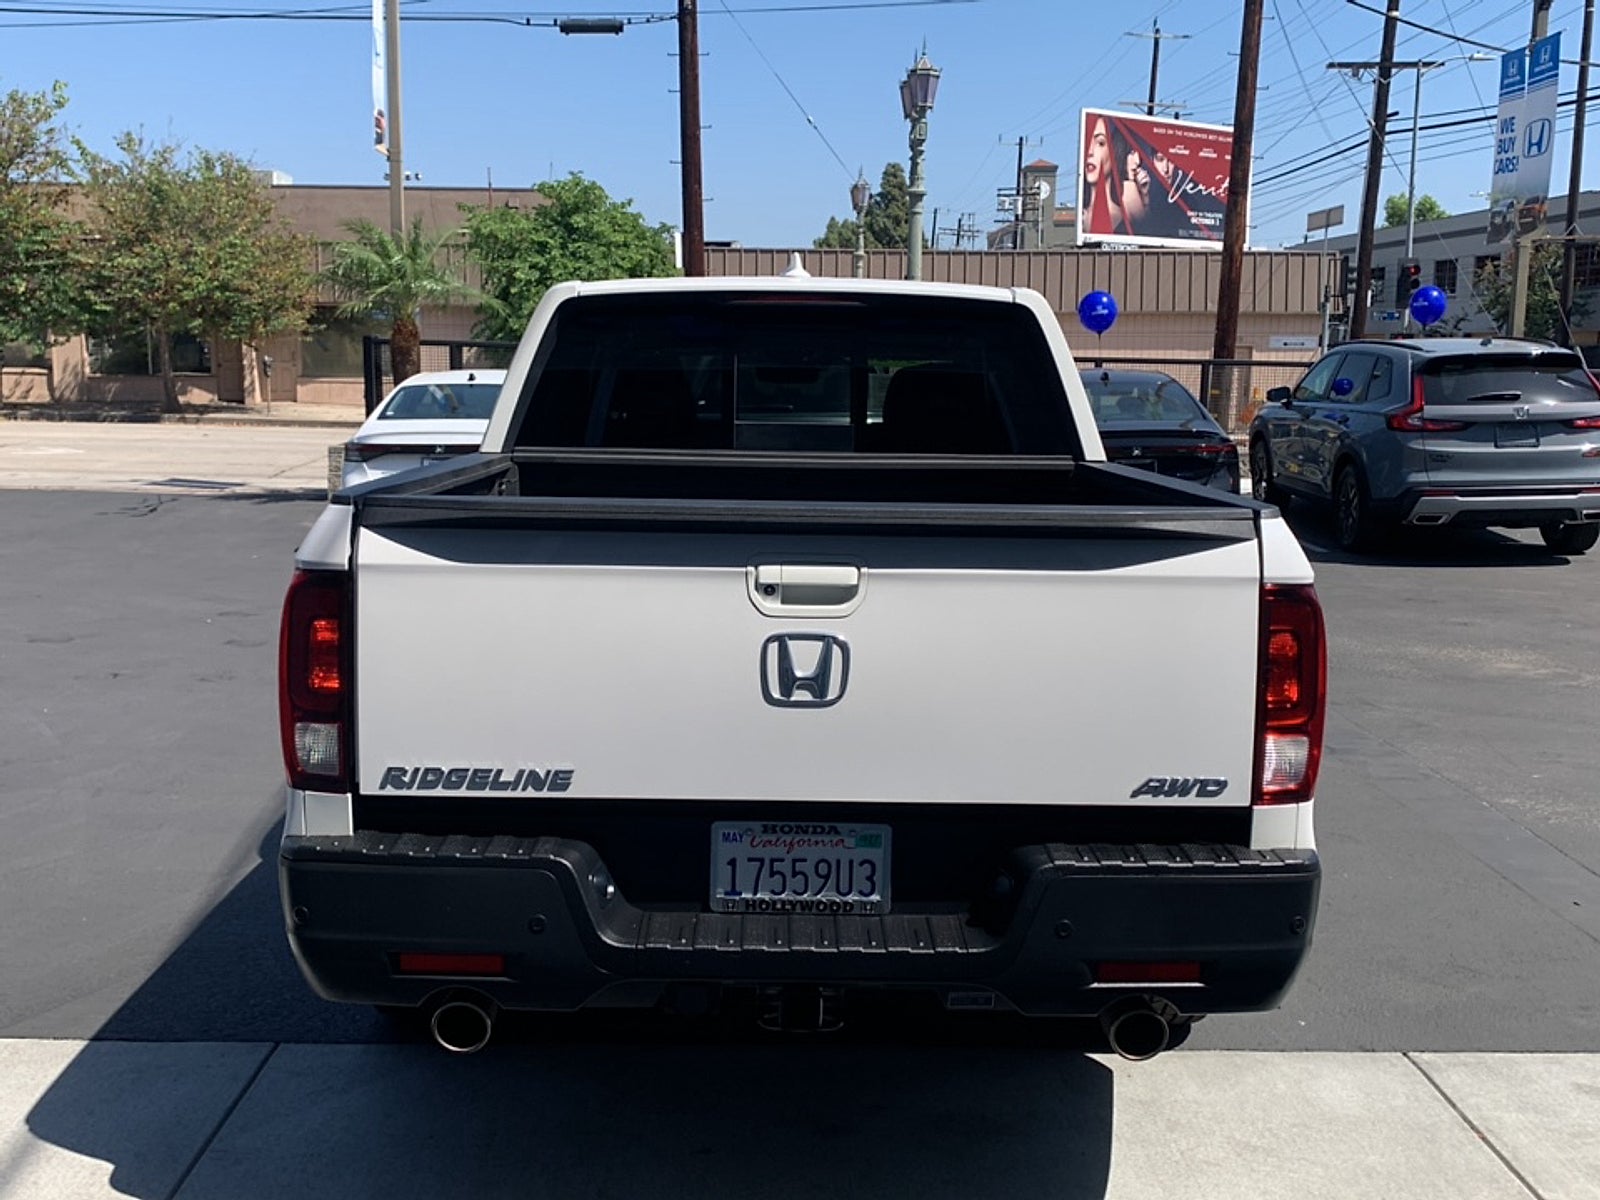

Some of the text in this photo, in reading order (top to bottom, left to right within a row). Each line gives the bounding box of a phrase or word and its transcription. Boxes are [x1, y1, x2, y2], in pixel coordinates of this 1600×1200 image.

[1500, 117, 1516, 133] WE
[1497, 136, 1517, 155] BUY
[1493, 156, 1519, 175] CARS!
[1168, 170, 1230, 203] Verit
[379, 766, 575, 792] RIDGELINE
[1129, 777, 1229, 799] AWD
[722, 831, 744, 843] MAY
[761, 823, 842, 836] HONDA
[750, 834, 856, 854] California
[724, 856, 877, 898] 17559U3
[745, 899, 855, 912] HOLLYWOOD
